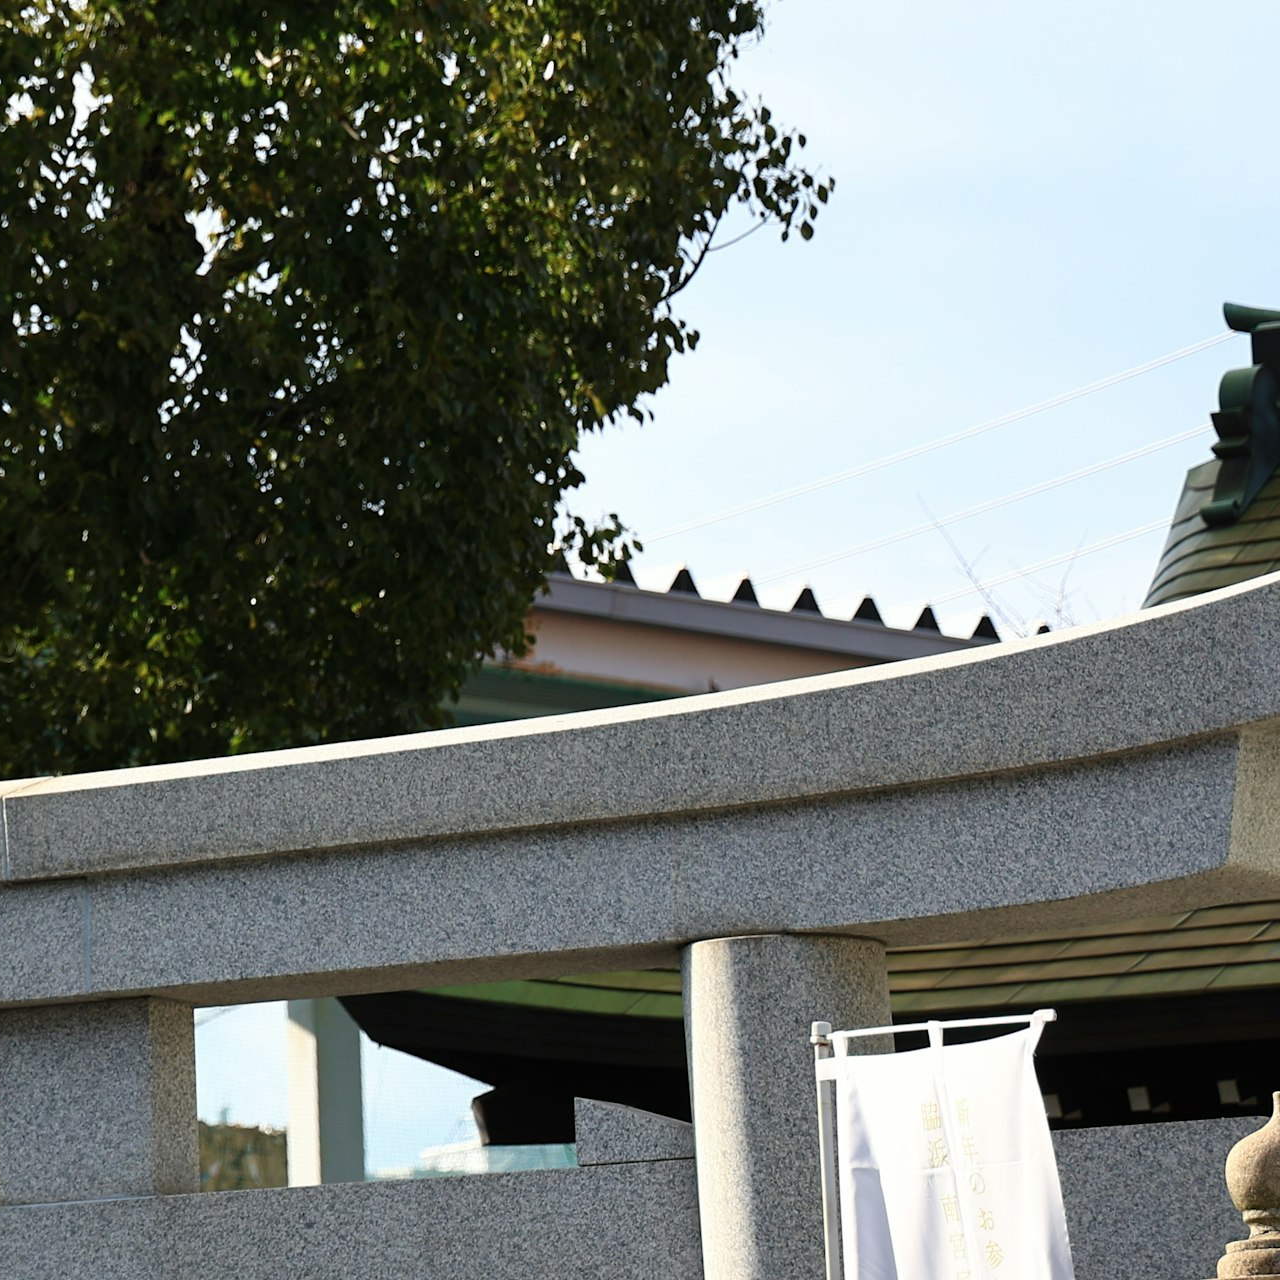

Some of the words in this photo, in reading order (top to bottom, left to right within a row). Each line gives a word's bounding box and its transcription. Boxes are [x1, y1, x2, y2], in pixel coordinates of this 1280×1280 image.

[954, 1096, 1006, 1280] 新年のお参
